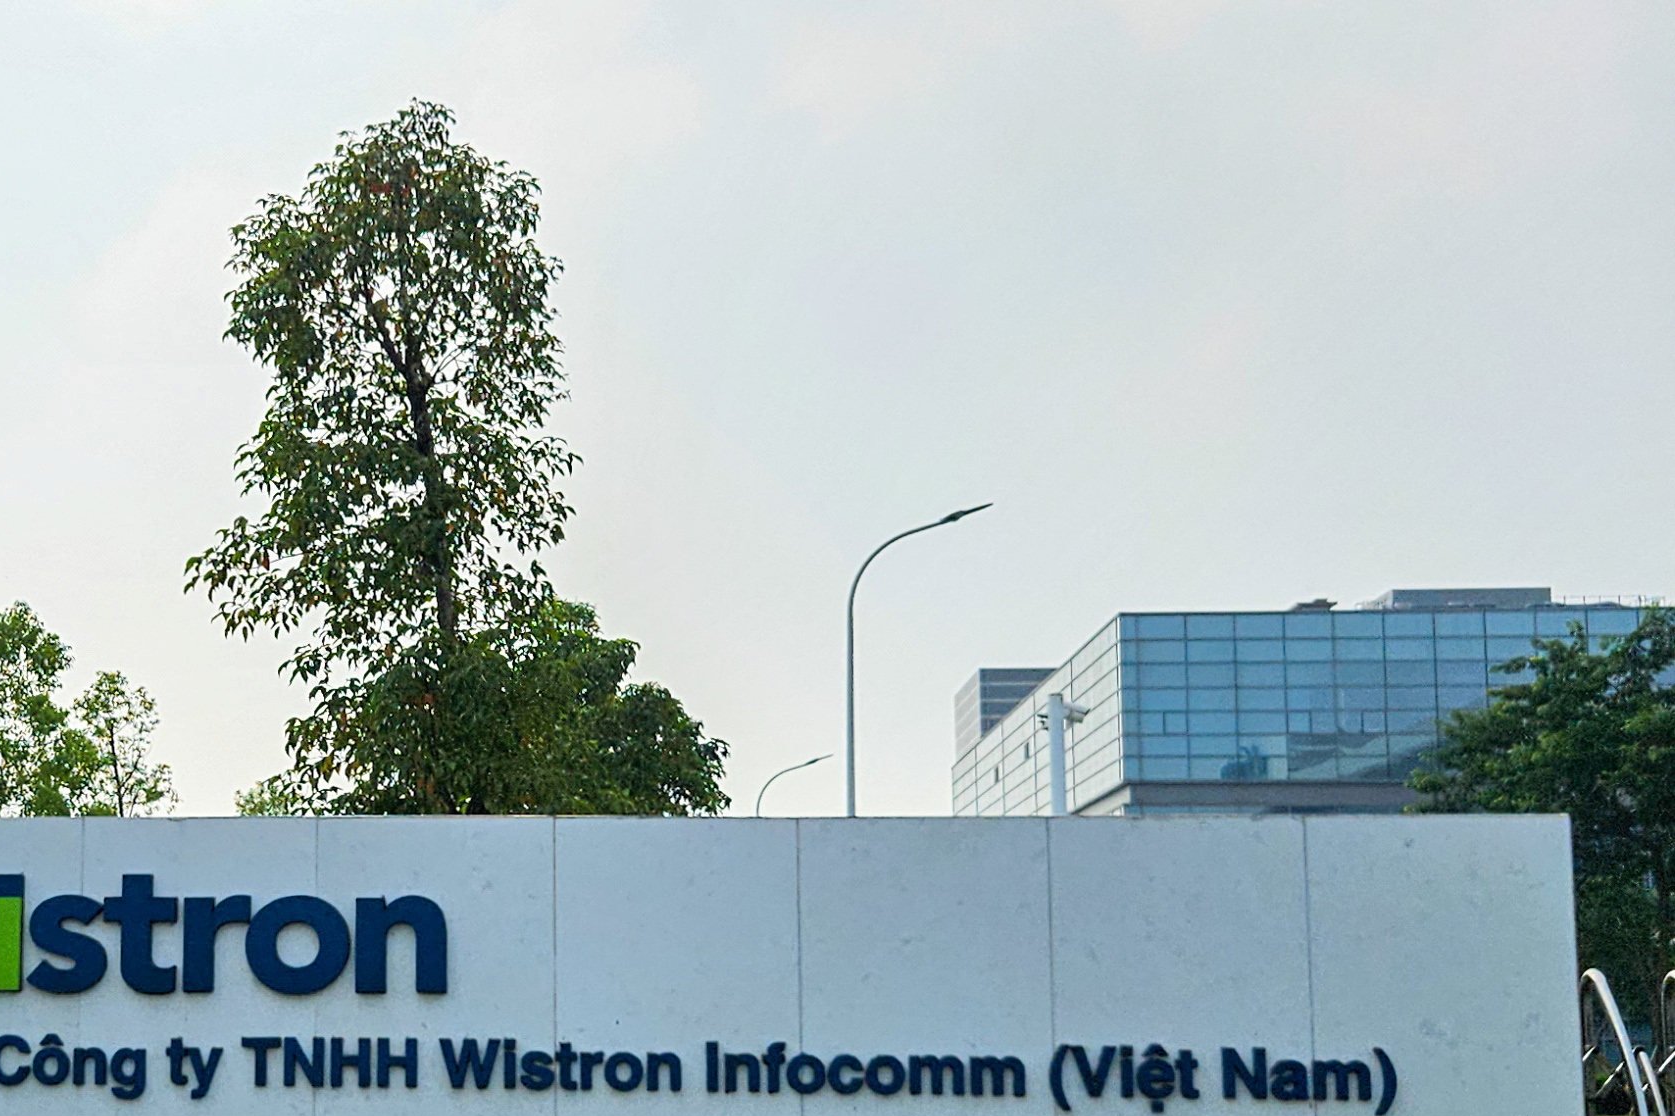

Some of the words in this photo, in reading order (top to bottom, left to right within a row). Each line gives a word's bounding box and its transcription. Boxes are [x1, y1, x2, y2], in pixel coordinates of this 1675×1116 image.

[166, 1037, 224, 1099] ty
[241, 1037, 419, 1088] TNHH
[439, 1038, 683, 1092] Wistron
[706, 1042, 1027, 1098] Infocomm
[1048, 1043, 1200, 1113] (Việt
[1221, 1047, 1399, 1116] Nam)
